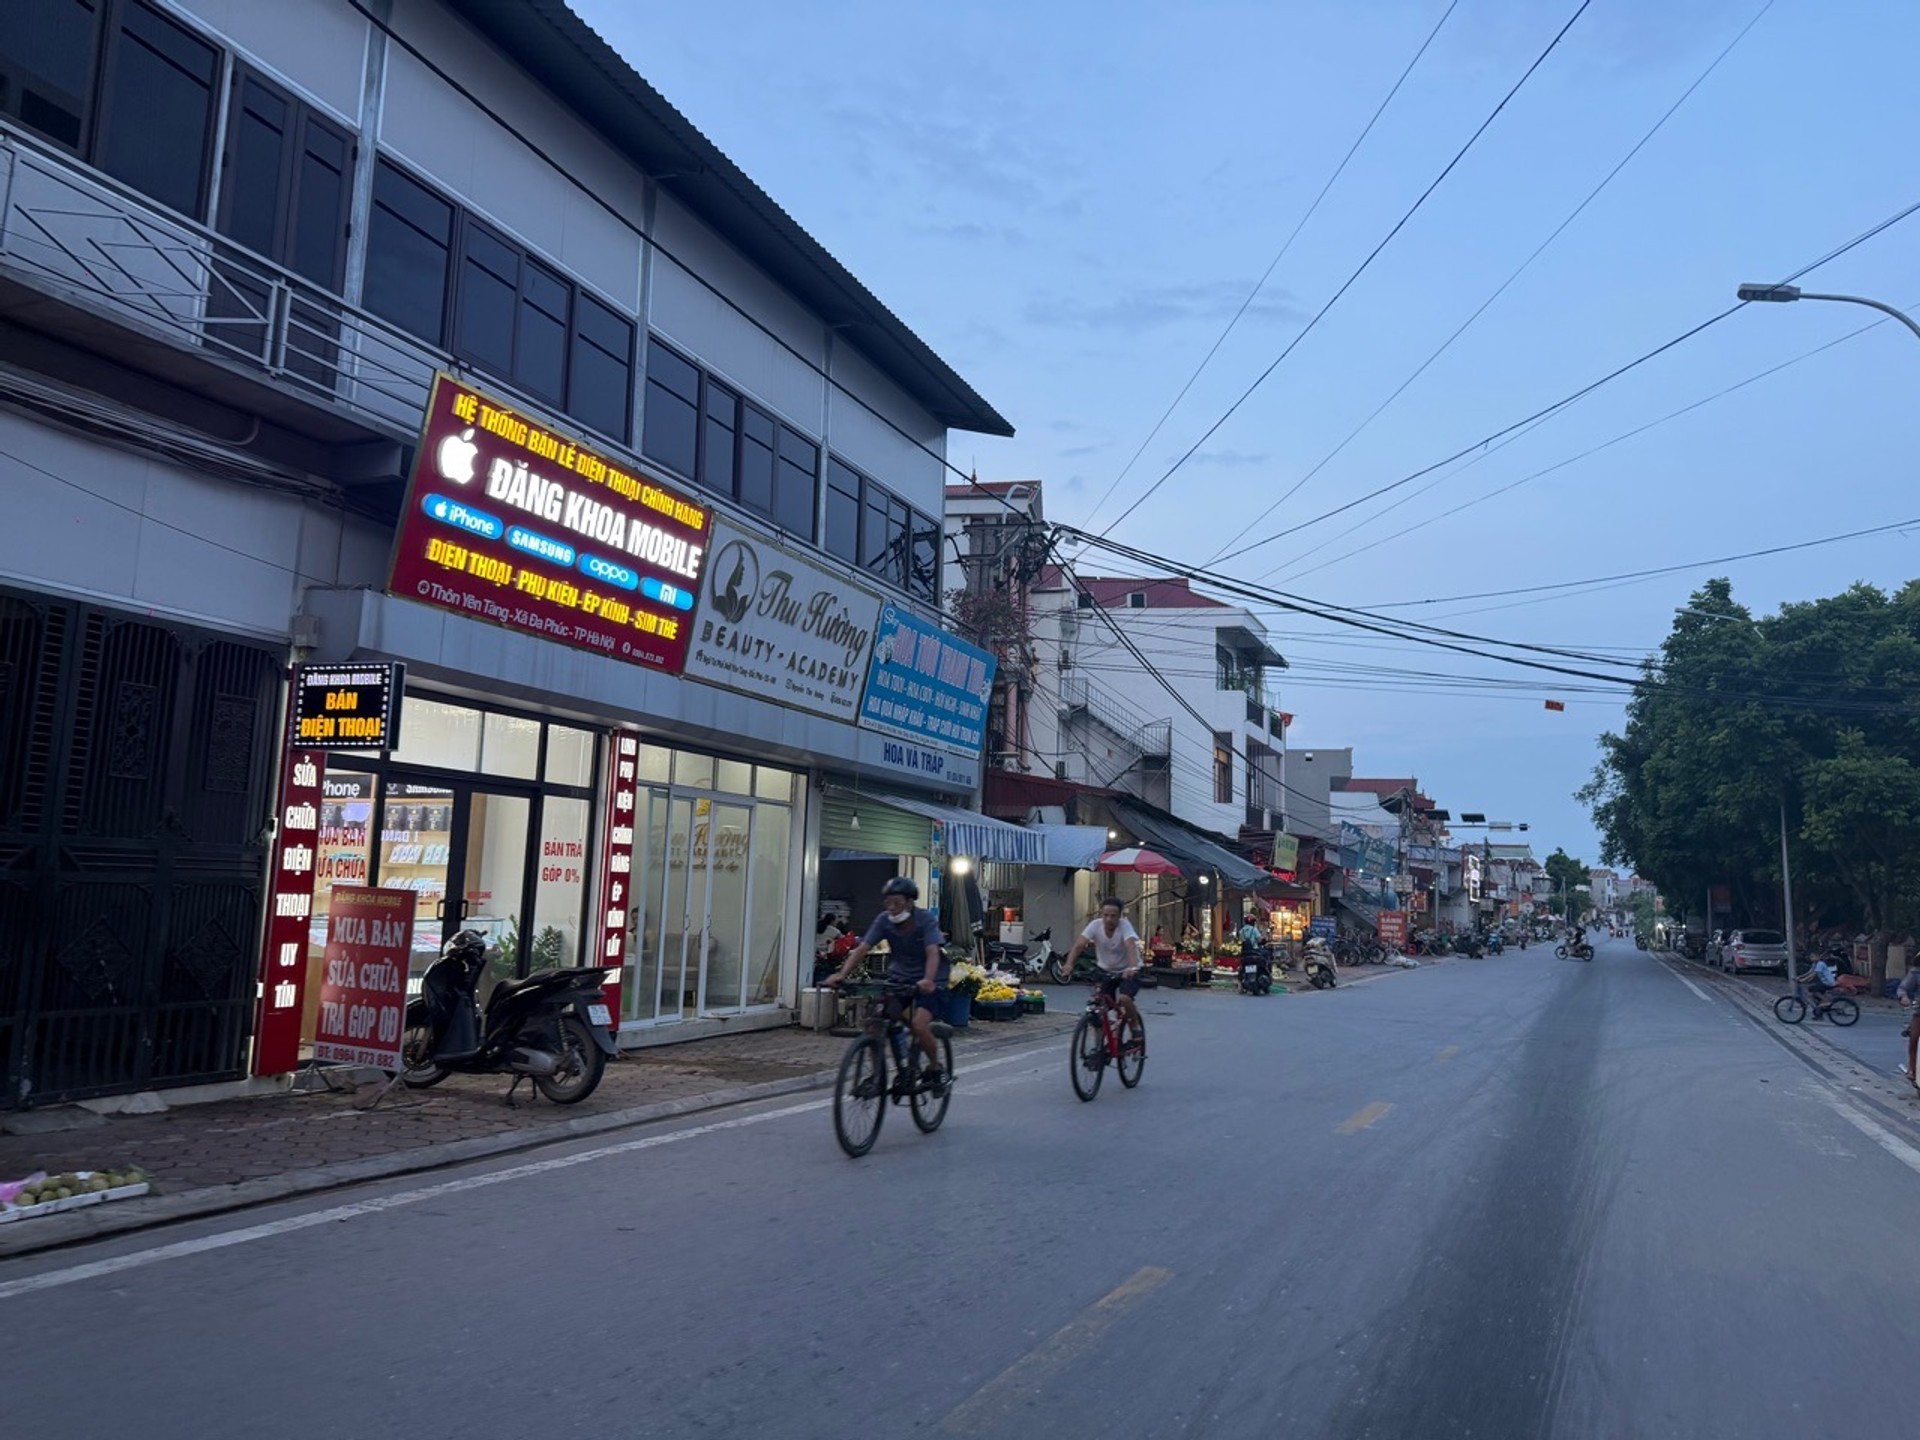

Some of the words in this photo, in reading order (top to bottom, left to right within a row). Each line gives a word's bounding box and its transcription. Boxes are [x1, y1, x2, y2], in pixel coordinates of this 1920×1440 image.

[453, 393, 478, 425] HỆ
[479, 405, 528, 446] THỐNG
[527, 429, 559, 460] BÁN
[558, 442, 577, 469] LẺ
[576, 453, 607, 483] ĐIỆN
[606, 468, 641, 501] THOẠI
[641, 486, 676, 516] CHÍNH
[449, 504, 495, 535] iPhone
[486, 457, 565, 522] ĐĂNG
[563, 490, 626, 550] KHOA
[627, 519, 703, 579] MOBILE
[512, 530, 572, 563] SAMSUNG
[425, 538, 468, 570] ĐIỆN
[468, 552, 513, 587] THOẠI
[516, 569, 547, 600] PHỤ
[546, 580, 578, 608] KIỆN
[581, 589, 600, 613] ÉP
[599, 597, 630, 624] KÍNH
[634, 610, 658, 633] SIM
[657, 615, 678, 640] THẺ
[431, 582, 460, 605] Thôn
[462, 592, 482, 612] Yên
[513, 608, 528, 624] Xã
[543, 618, 569, 636] Phúc
[574, 626, 587, 640] TP
[757, 570, 802, 627] Thu
[802, 591, 868, 667] Hường
[700, 620, 775, 662] BEAUTY
[785, 651, 859, 692] ACADEMY
[351, 673, 382, 686] MOBILE
[325, 688, 358, 710] BÁN
[300, 714, 335, 740] ĐIỆN
[337, 716, 381, 740] THOẠI
[292, 755, 316, 787] SỬA
[883, 742, 904, 766] HOA
[906, 745, 919, 769] VÀ
[921, 751, 944, 775] TRÁP
[285, 802, 316, 830] CHỮA
[283, 843, 312, 876] ĐIỆN
[544, 837, 564, 857] BÁN
[566, 839, 583, 858] TRẢ
[542, 864, 563, 882] GÓP
[564, 868, 580, 883] 0%
[276, 893, 310, 922] THOẠI
[333, 916, 367, 945] MUA
[370, 912, 406, 948] BÁN
[280, 943, 298, 966] UY
[327, 949, 356, 988] SỬA
[360, 957, 399, 992] CHỮA
[274, 979, 296, 1008] TÍN
[321, 994, 345, 1036] TRẢ
[348, 999, 376, 1040] GÓP
